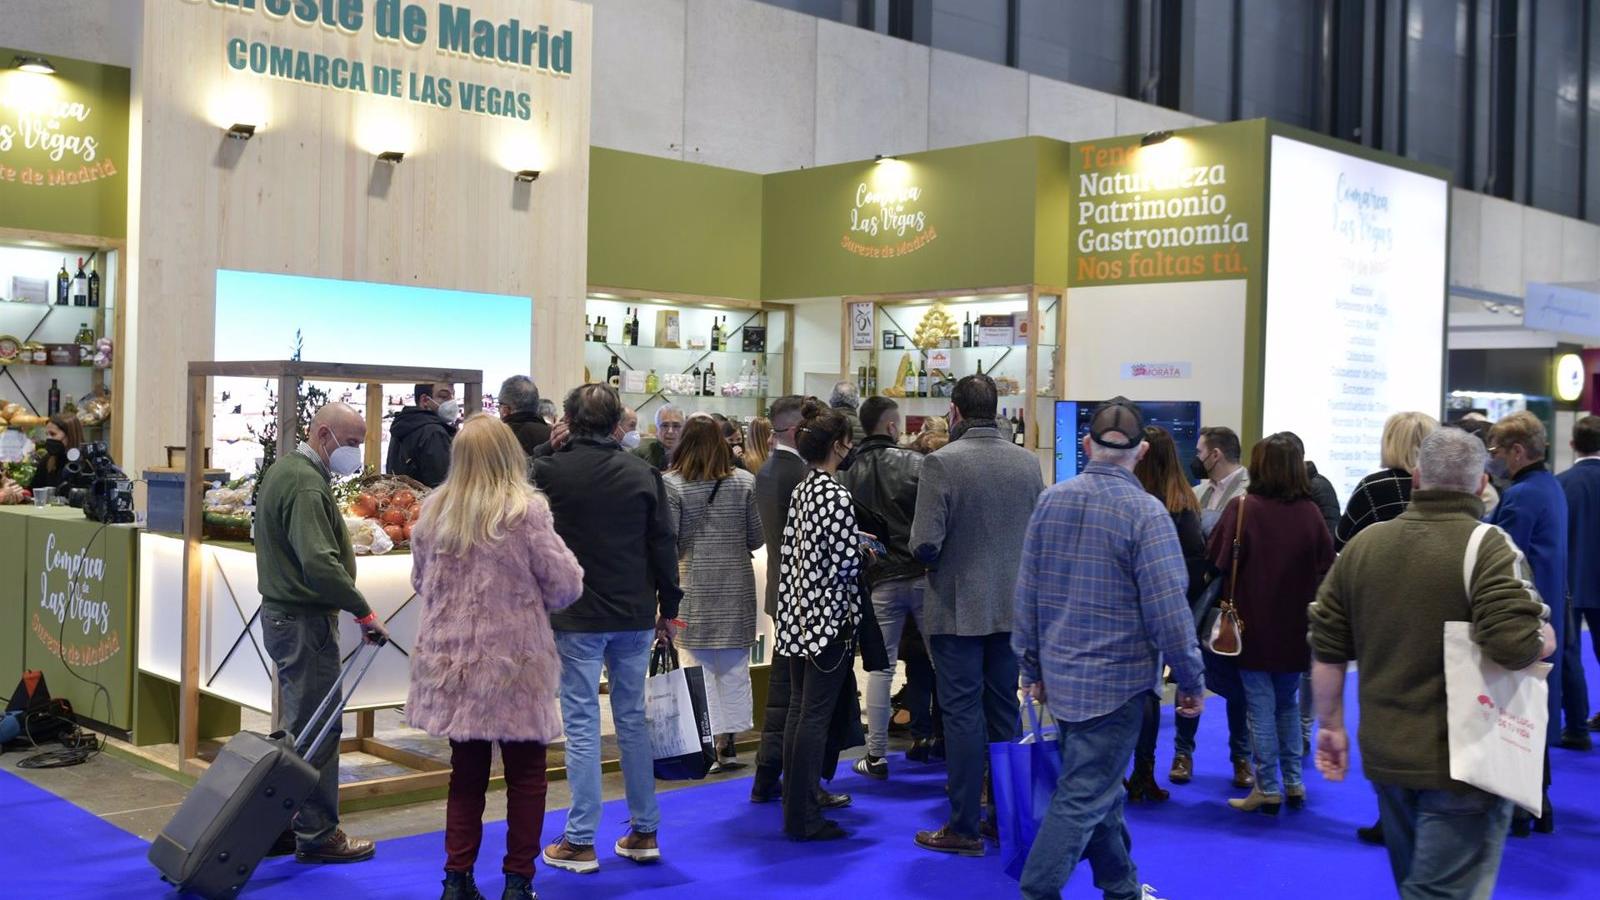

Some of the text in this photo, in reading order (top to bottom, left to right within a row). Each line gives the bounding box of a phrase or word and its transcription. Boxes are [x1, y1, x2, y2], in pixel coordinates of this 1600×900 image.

[375, 0, 427, 44] de
[438, 4, 572, 74] Madrid
[227, 38, 531, 120] COMARCA DE LAS VEGAS
[22, 166, 44, 186] de
[47, 158, 117, 186] Madrid
[1079, 164, 1226, 197] Natureza
[856, 183, 922, 208] Comca
[1078, 188, 1226, 225] Patrimonio
[850, 207, 926, 237] Las Vegas
[1077, 215, 1249, 253] Gastronomía
[1077, 244, 1249, 280] Nos faltas tú.
[46, 532, 106, 582] Comarca
[41, 571, 111, 635] Las Vegas
